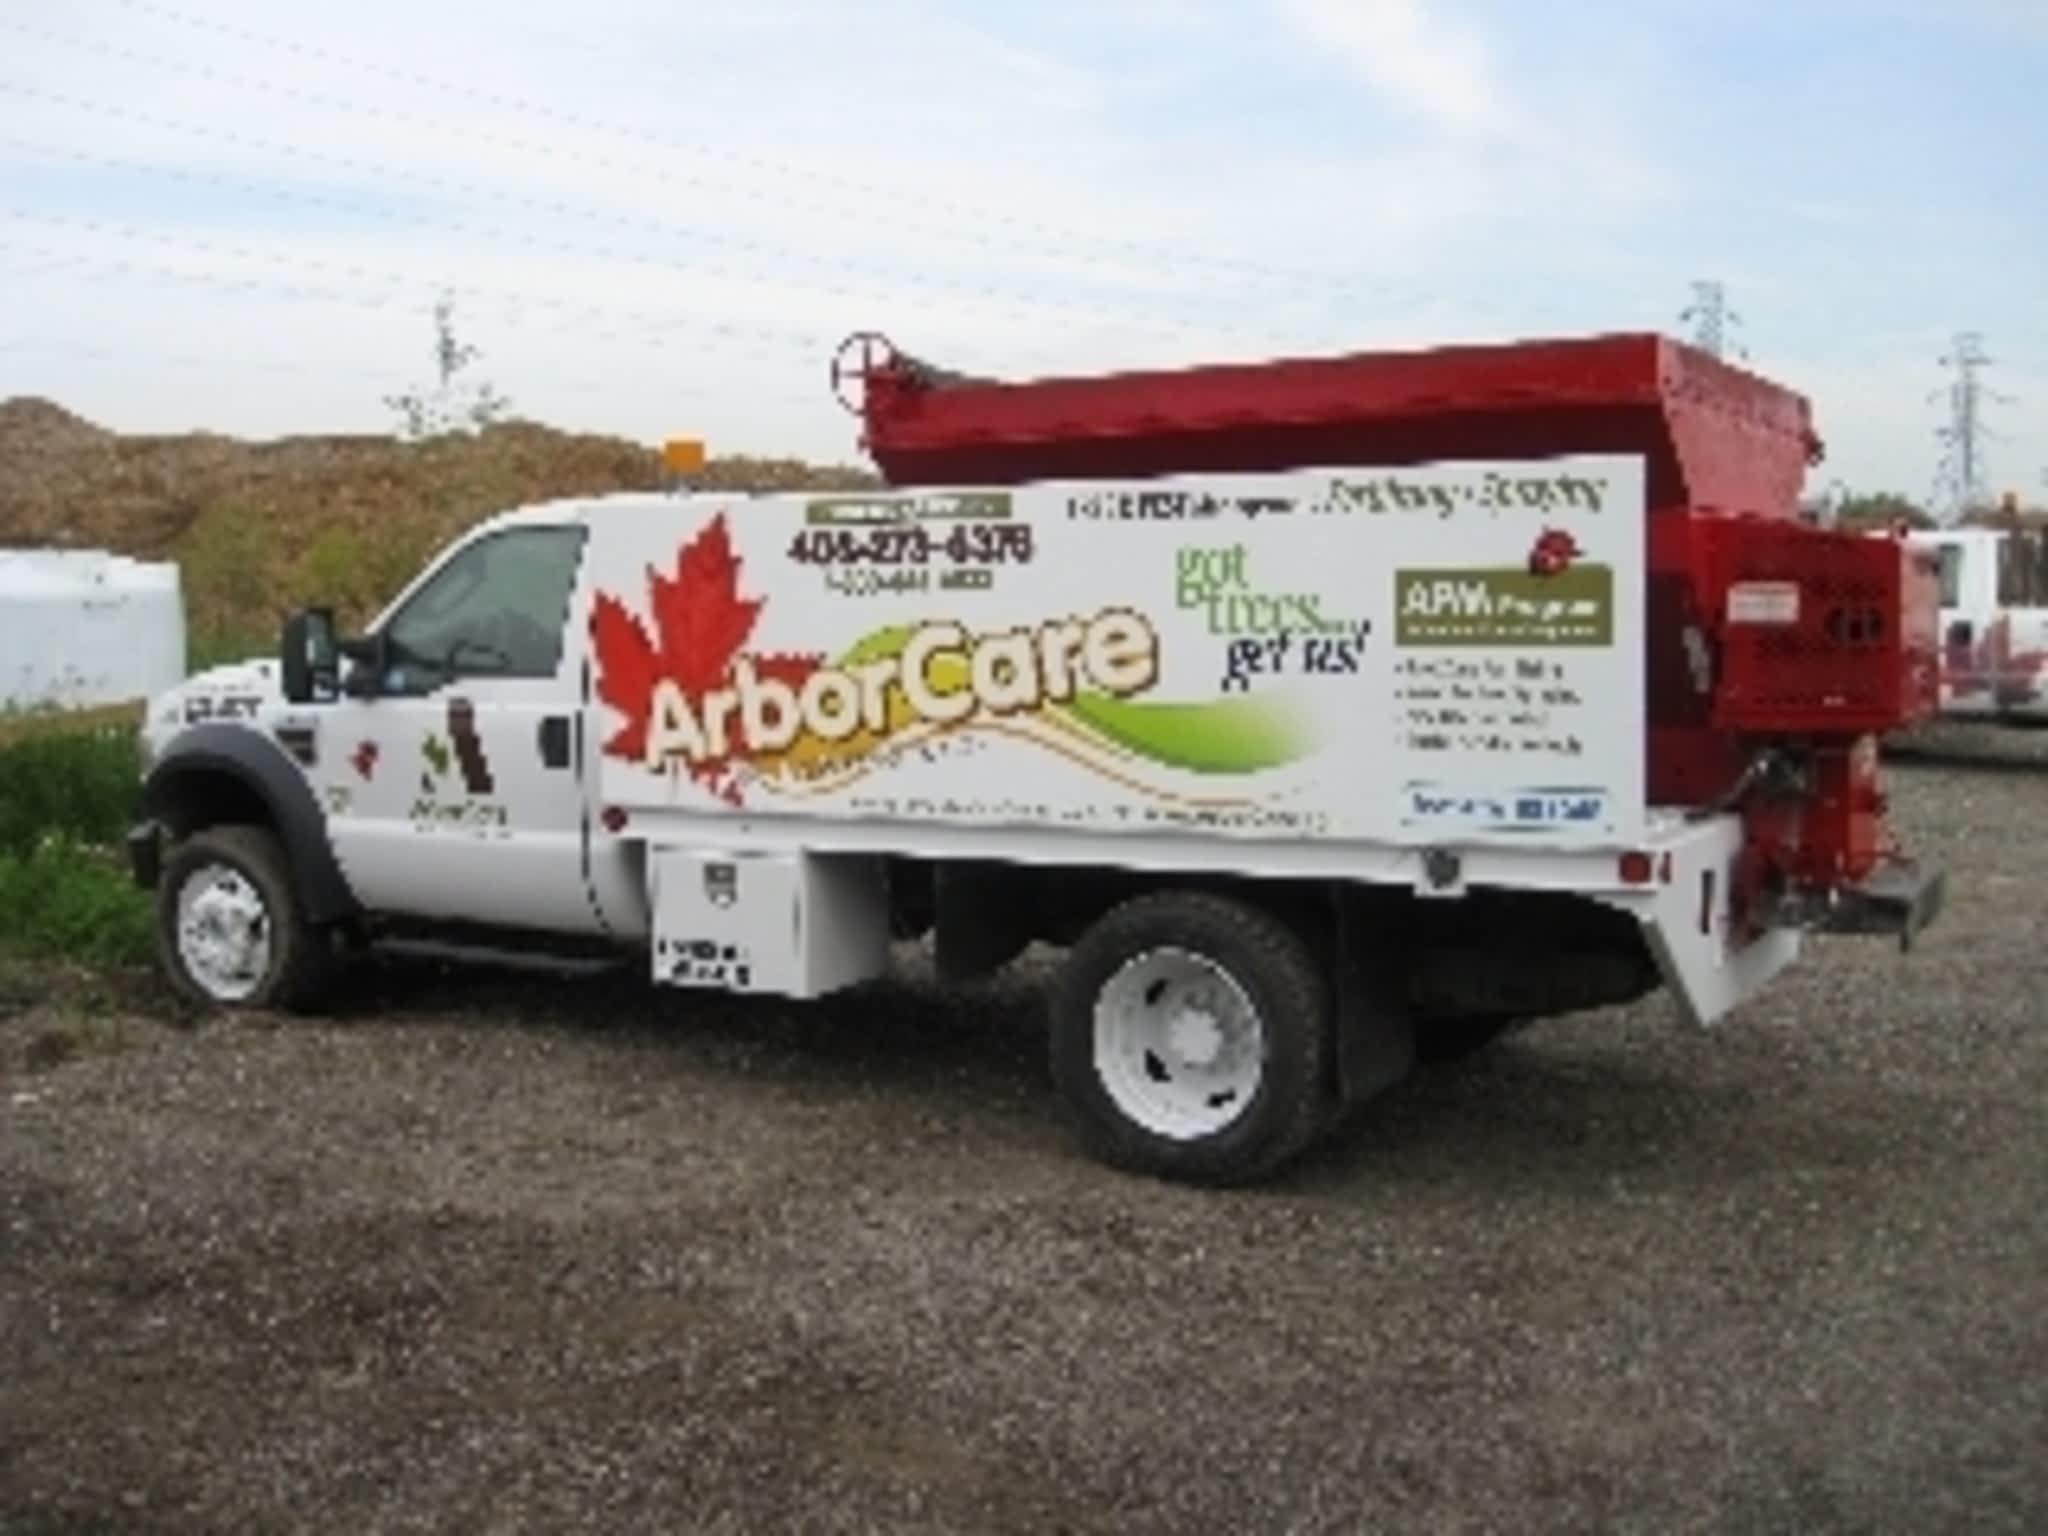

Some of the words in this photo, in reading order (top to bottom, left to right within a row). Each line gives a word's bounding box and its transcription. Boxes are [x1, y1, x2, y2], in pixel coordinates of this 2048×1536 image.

[1177, 544, 1247, 609] got
[646, 605, 1159, 773] ArborCare
[1221, 632, 1287, 693] get
